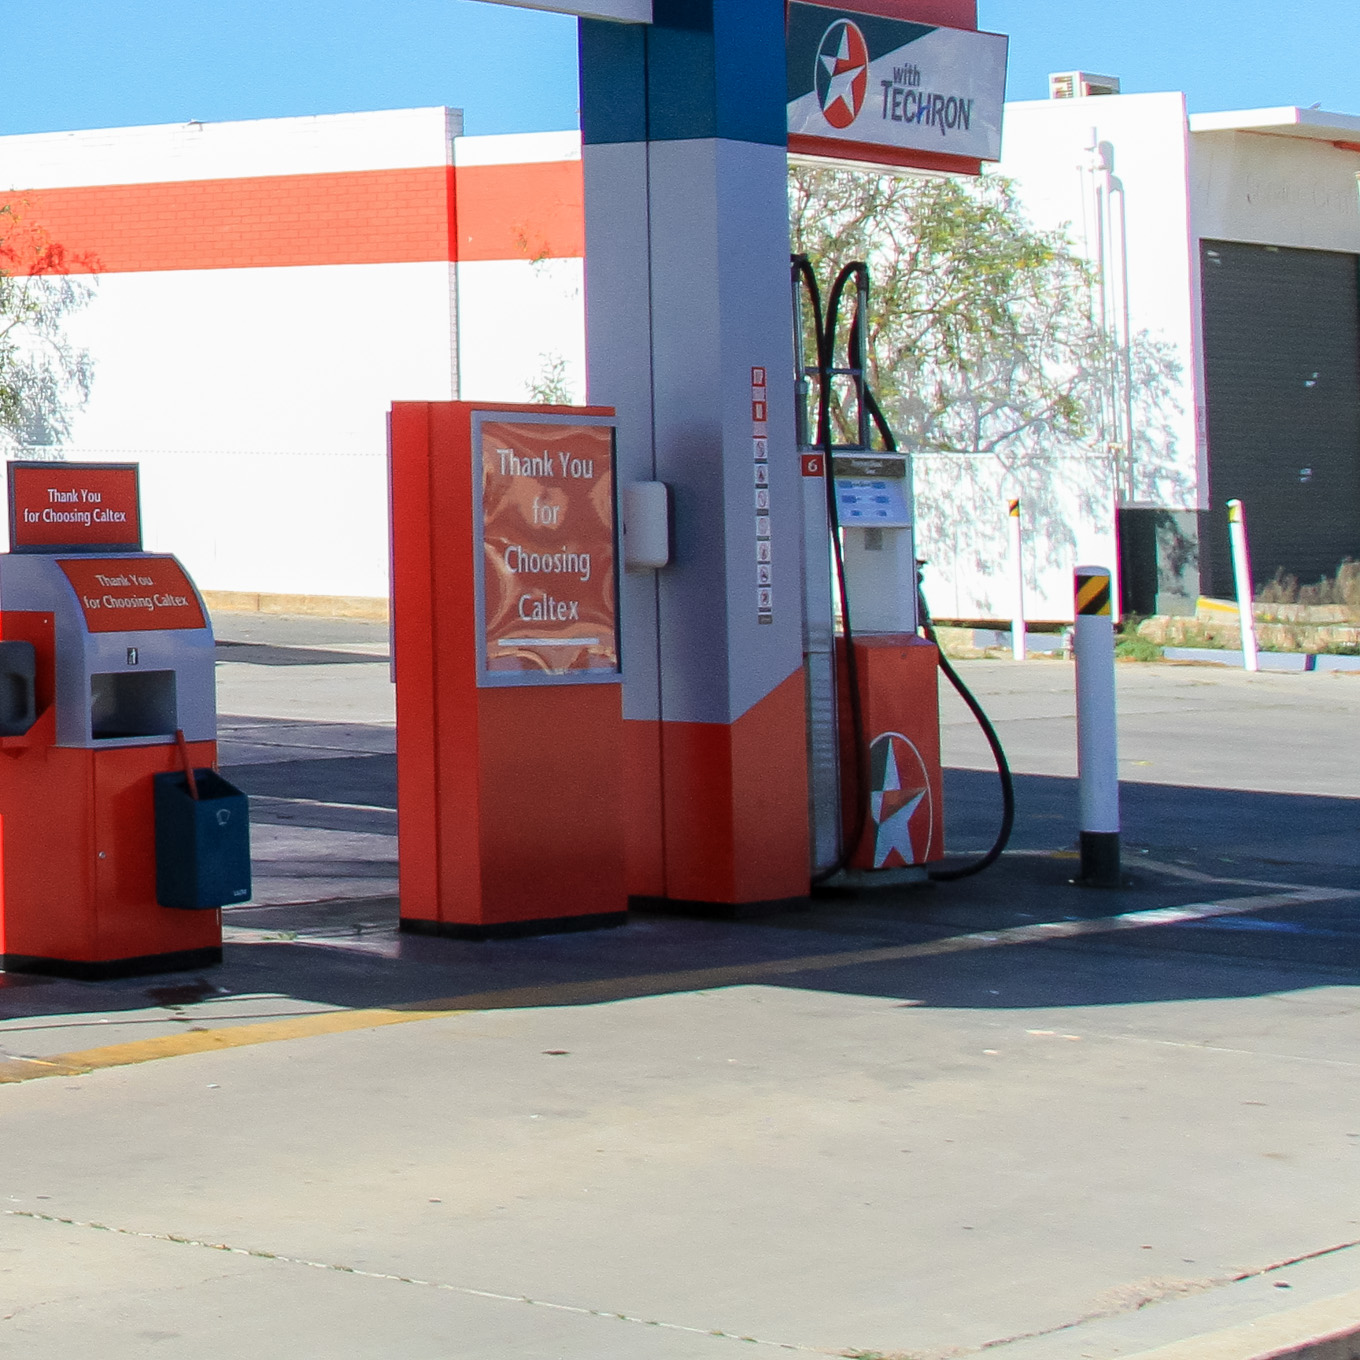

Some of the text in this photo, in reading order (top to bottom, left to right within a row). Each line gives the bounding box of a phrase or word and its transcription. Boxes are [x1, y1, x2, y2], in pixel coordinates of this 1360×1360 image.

[893, 63, 920, 87] with
[881, 80, 971, 136] TECHRON
[496, 449, 593, 479] Thank You
[807, 459, 818, 472] 6
[47, 488, 101, 503] Thank You
[24, 508, 126, 526] for Choosing Caltex
[533, 497, 560, 525] for
[504, 545, 591, 581] Choosing
[95, 574, 153, 586] Thank You
[83, 594, 188, 611] for Choosing Caltex
[518, 593, 579, 621] Caltex
